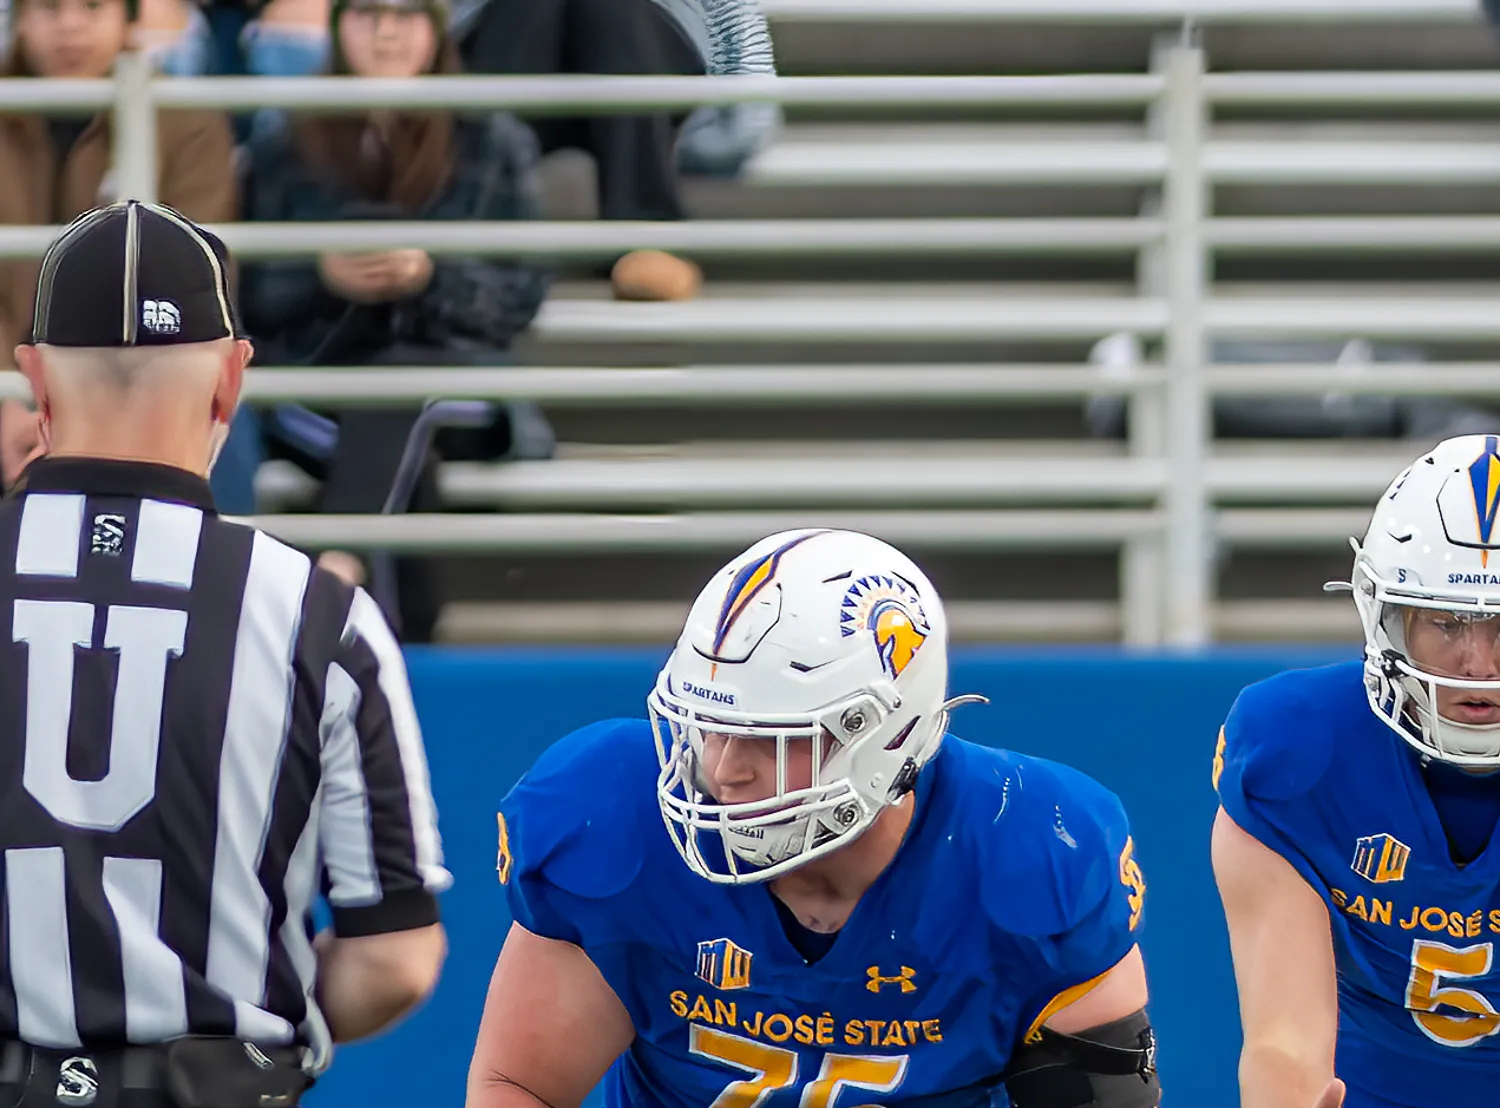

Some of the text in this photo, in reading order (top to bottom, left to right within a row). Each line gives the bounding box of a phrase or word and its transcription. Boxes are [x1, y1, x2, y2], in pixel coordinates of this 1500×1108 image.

[12, 598, 189, 833] U
[682, 681, 735, 706] SPARTANS
[1330, 888, 1393, 926] SAN
[1400, 906, 1483, 938] JOSÉ
[669, 990, 944, 1047] SAN JOSÉ STATE
